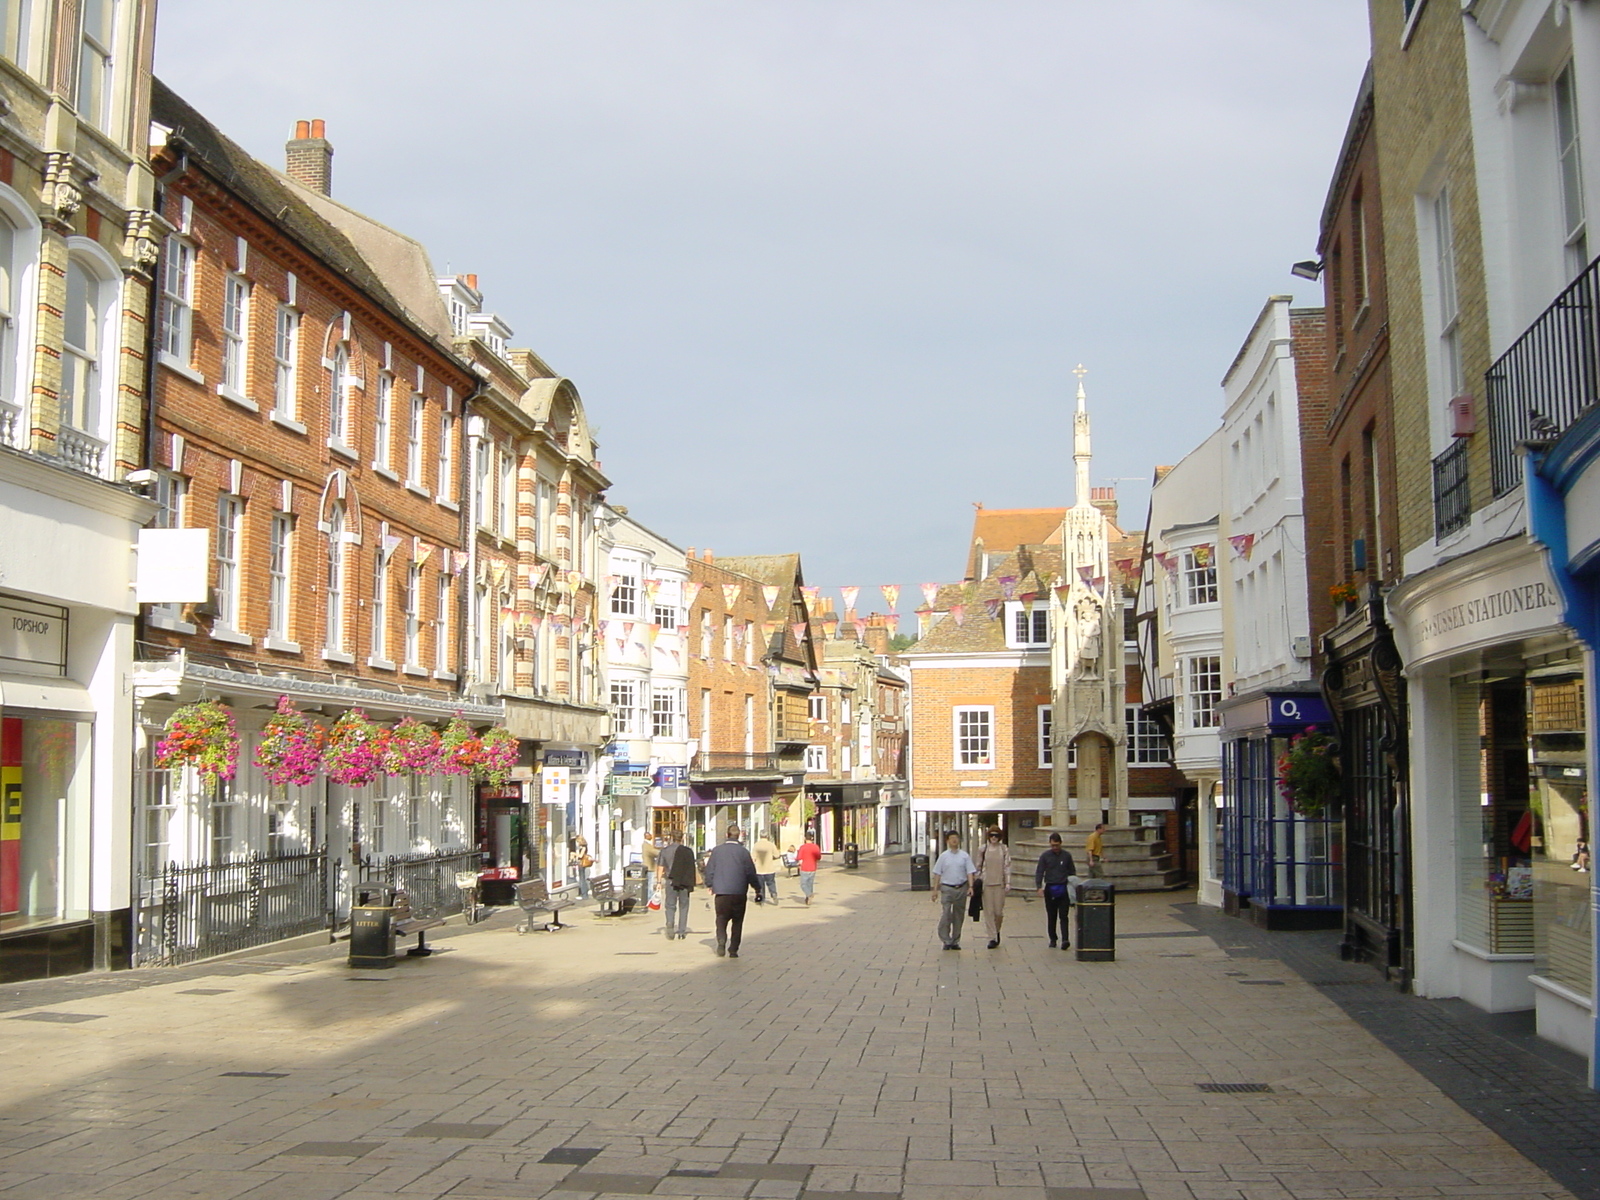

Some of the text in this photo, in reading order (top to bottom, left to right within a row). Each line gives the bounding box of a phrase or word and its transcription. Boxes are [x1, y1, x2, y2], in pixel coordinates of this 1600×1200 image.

[1432, 604, 1465, 637] SUSSEX
[1468, 582, 1557, 625] STATIONERS
[12, 617, 49, 635] TOPSHOP
[1280, 699, 1301, 720] O2
[715, 787, 732, 802] The
